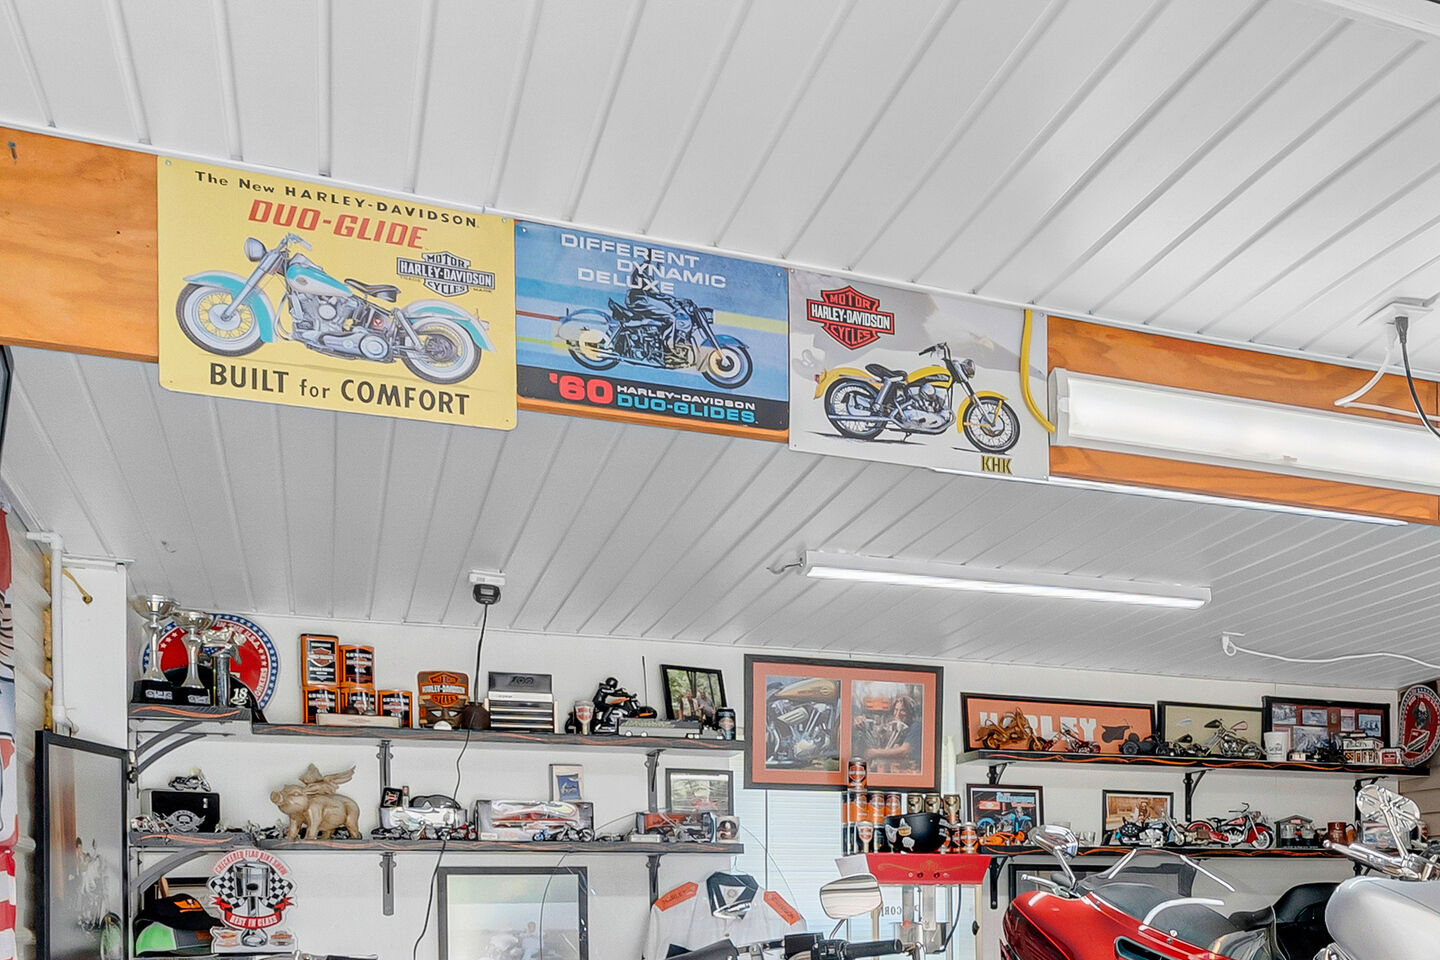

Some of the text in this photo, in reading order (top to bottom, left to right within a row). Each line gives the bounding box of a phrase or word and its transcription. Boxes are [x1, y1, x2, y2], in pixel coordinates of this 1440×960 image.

[195, 170, 477, 228] The New HARLEY-DAVIDSON
[248, 199, 427, 249] DUO-GLIDE
[427, 253, 465, 268] MOTOR
[561, 233, 699, 268] DIFFERENT
[400, 260, 493, 287] HARLEY-DAVIDSON
[577, 267, 675, 295] DELUXE
[616, 259, 727, 289] DYNAMIC
[427, 281, 466, 295] CYCLES
[829, 291, 872, 310] MOTOR
[811, 303, 891, 330] HARLEY-DAVIDSON
[830, 325, 872, 345] CYCLES
[210, 363, 470, 415] BUILT for COMFORT
[549, 373, 614, 404] '60
[617, 385, 756, 411] HARLEY-DAVIDSON
[617, 394, 756, 423] DUO-GLIDES
[981, 455, 1013, 475] KHK
